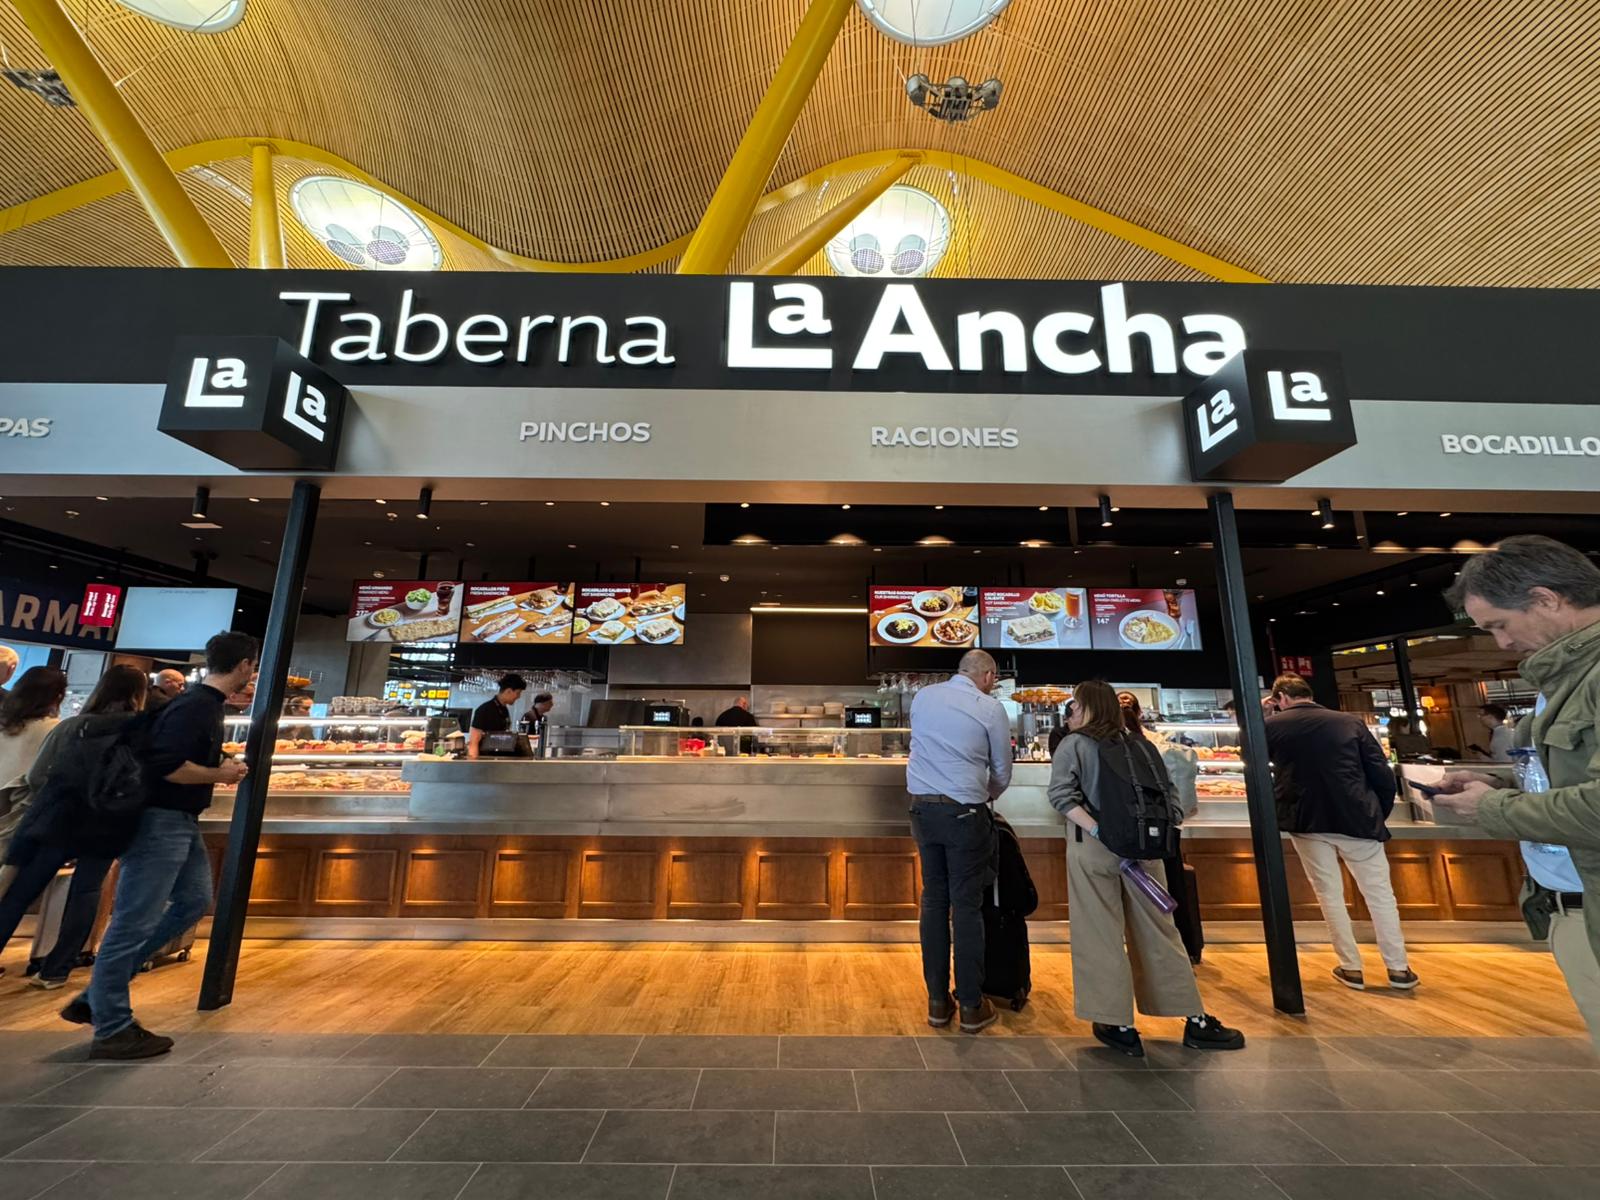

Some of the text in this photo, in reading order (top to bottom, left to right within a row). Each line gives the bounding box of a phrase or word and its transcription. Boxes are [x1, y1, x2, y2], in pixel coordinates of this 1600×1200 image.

[279, 281, 1248, 376] Taberna La Ancha
[184, 357, 247, 408] La
[282, 371, 326, 442] La
[1267, 371, 1332, 421] La
[519, 421, 651, 443] PINCHOS
[871, 426, 1020, 449] RACIONES
[1196, 389, 1238, 453] La
[1441, 434, 1600, 457] BOCADILLO
